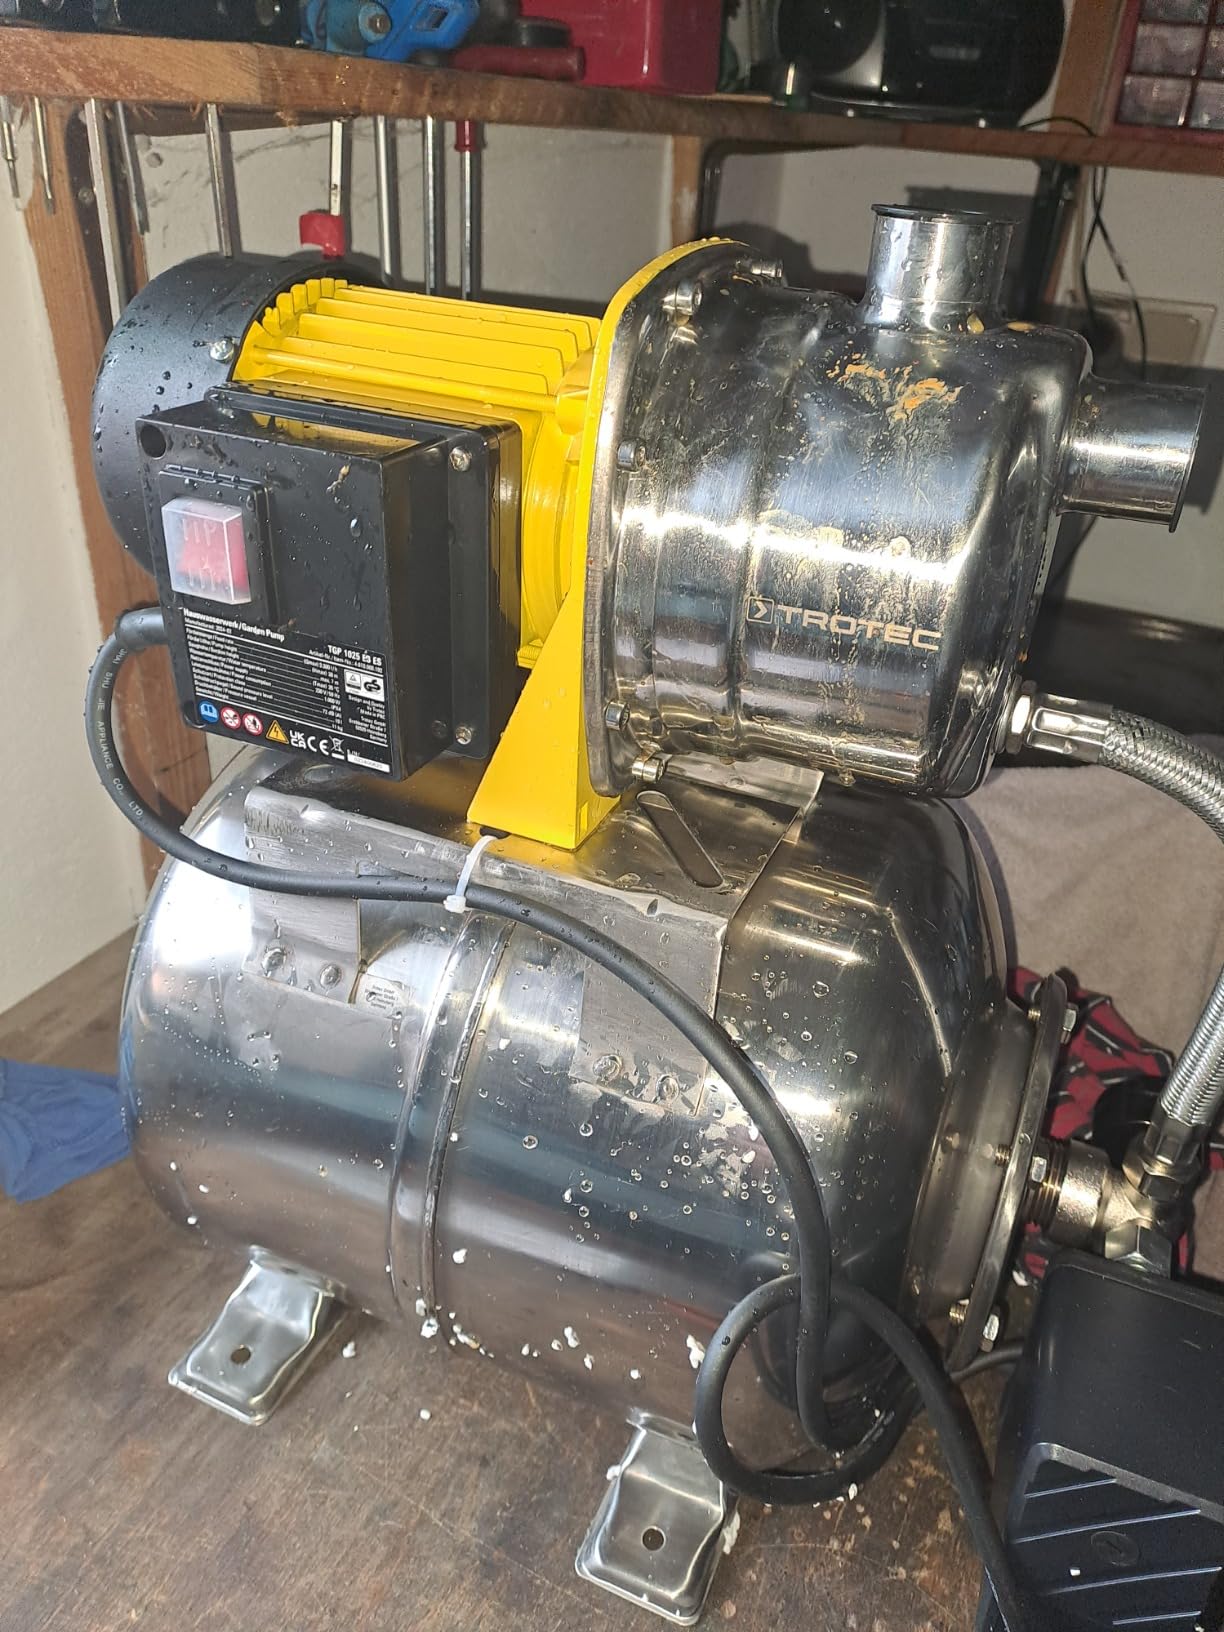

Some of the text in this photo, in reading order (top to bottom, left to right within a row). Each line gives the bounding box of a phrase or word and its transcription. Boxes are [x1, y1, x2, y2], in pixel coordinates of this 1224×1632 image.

[266, 628, 285, 643] Pump
[777, 604, 942, 651] TROTEC
[328, 644, 342, 656] TGP
[343, 648, 360, 661] 1025
[97, 720, 114, 770] APPLIANCE
